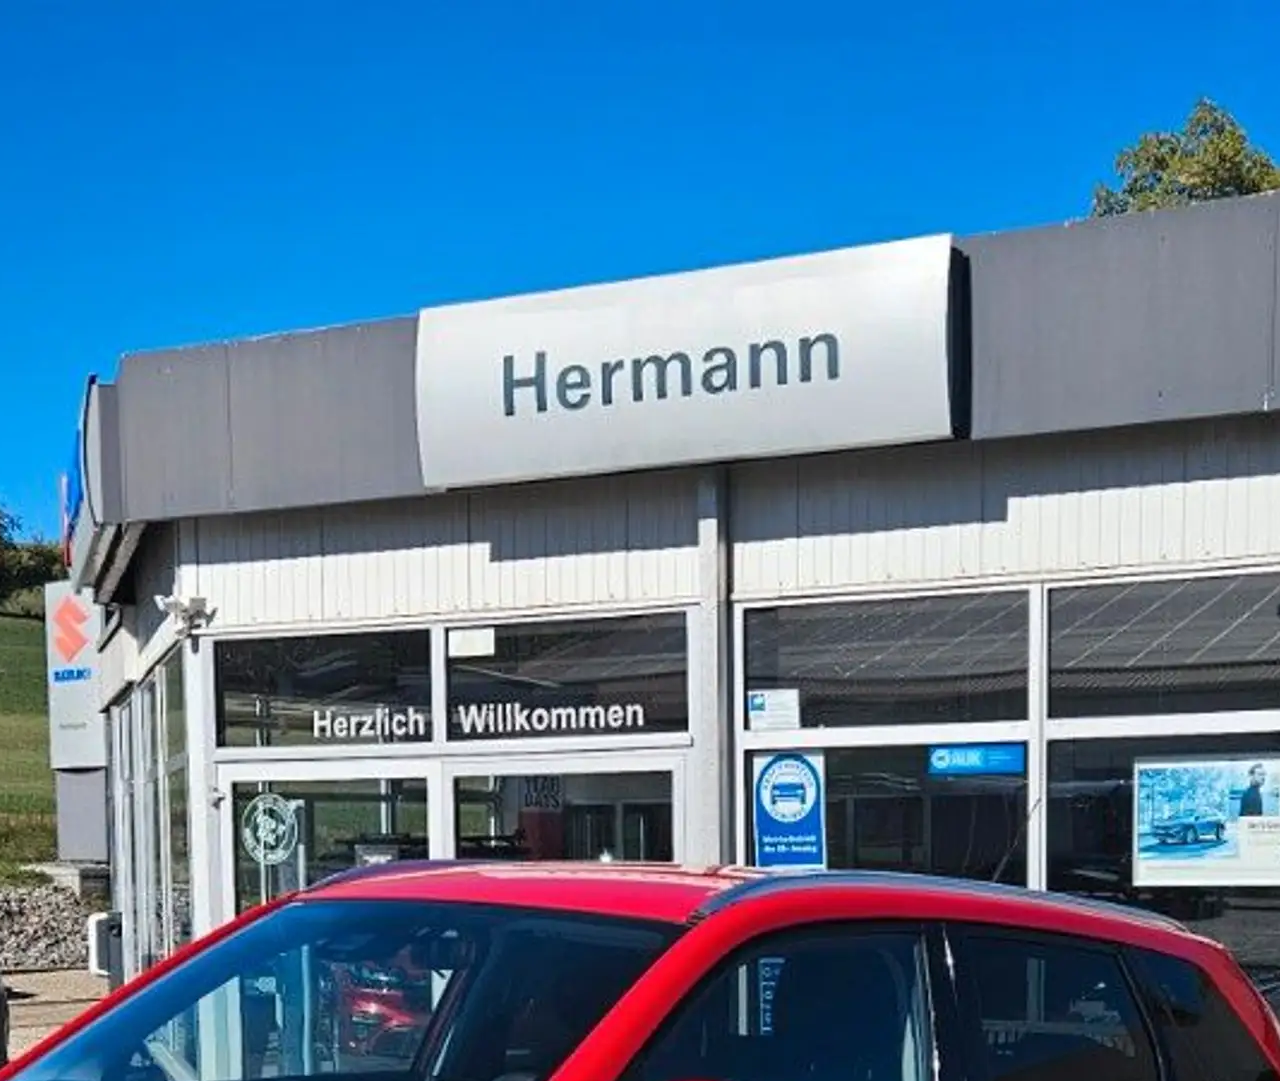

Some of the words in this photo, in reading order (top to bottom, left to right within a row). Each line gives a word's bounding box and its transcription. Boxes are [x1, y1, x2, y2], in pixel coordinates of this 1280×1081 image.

[503, 331, 840, 416] Hermann
[312, 702, 425, 739] Herzlich
[458, 702, 645, 735] Willkommen
